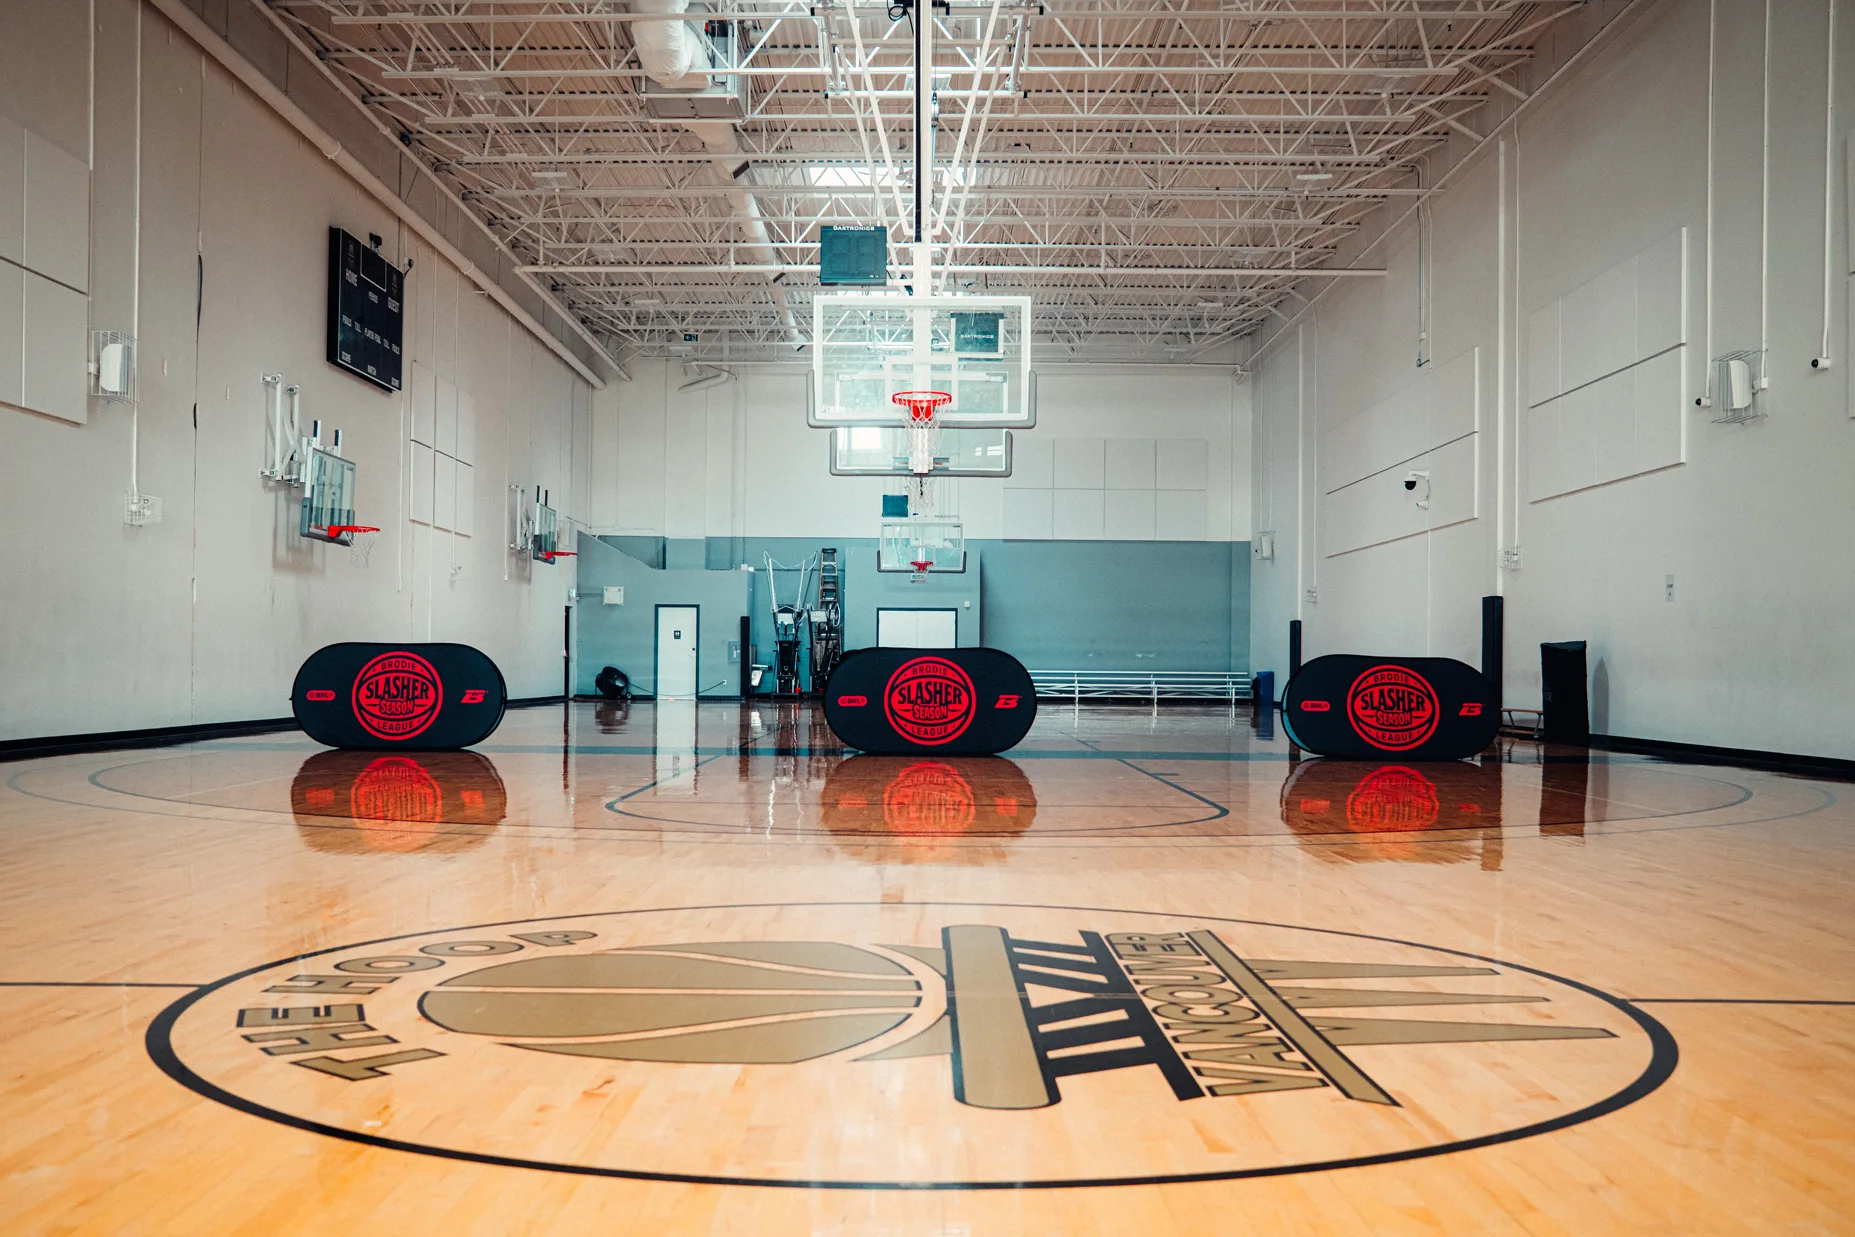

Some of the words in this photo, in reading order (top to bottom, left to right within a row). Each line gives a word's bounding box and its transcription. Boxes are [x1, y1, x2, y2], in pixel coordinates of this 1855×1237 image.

[345, 268, 358, 287] HOME
[387, 297, 400, 314] GUEST
[381, 660, 417, 671] BRODIE
[911, 665, 948, 676] BRODIE
[1373, 673, 1410, 684] BRODIE
[365, 676, 430, 701] SLASHER
[897, 681, 963, 705] SLASHER
[380, 700, 414, 715] SEASON
[1360, 688, 1426, 712] SLASHER
[913, 705, 947, 719] SEASON
[1376, 711, 1412, 725] SEASON
[377, 720, 414, 731] LEAGUE
[911, 725, 949, 737] LEAGUE
[1375, 731, 1414, 742] LEAGUE
[261, 930, 598, 995] HOOP
[1104, 931, 1331, 1098] VANCOUVER
[236, 1003, 448, 1082] THE
